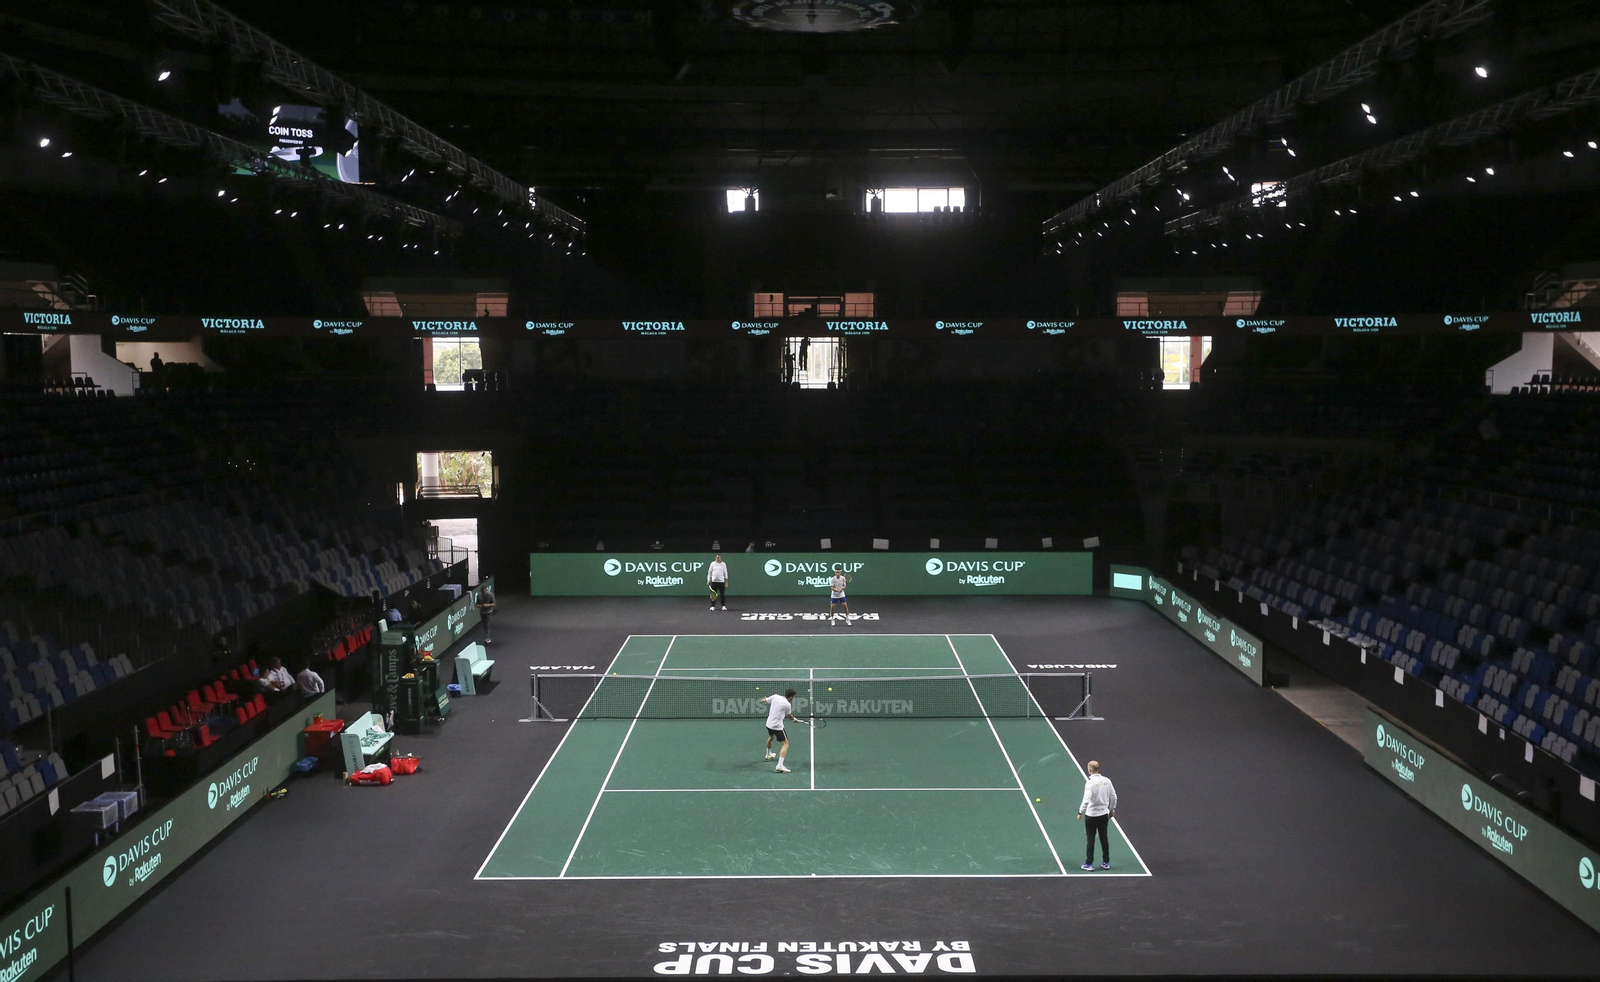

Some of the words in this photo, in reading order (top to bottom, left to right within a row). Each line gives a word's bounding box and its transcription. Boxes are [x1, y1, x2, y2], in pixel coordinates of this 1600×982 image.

[269, 126, 289, 136] COIN
[290, 128, 313, 138] TOSS
[24, 313, 72, 325] VICTORIA
[201, 318, 265, 329] VICTORIA
[1334, 317, 1398, 328] VICTORIA
[1531, 312, 1581, 323] VICTORIA
[412, 321, 477, 330] VICTORIA
[622, 322, 685, 330] VICTORIA
[826, 322, 888, 330] VICTORIA
[1123, 320, 1188, 330] VICTORIA
[625, 562, 667, 573] DAVIS
[671, 562, 702, 573] CUP
[786, 563, 828, 573] DAVIS
[832, 563, 862, 573] CUP
[947, 562, 989, 572] DAVIS
[992, 562, 1024, 572] CUP
[646, 576, 684, 588] Rakuten
[806, 576, 832, 588] Rakut
[967, 575, 1004, 586] Rakuten
[385, 649, 400, 684] Camps
[387, 684, 398, 693] &
[712, 699, 768, 714] DAVIS
[816, 699, 832, 715] by
[837, 700, 913, 714] RAKUTEN
[1386, 734, 1407, 758] DAVIS
[1408, 750, 1424, 769] CUP
[1395, 758, 1414, 782] Rakuten
[219, 768, 241, 797] DAVIS
[243, 757, 258, 778] CUP
[230, 785, 250, 808] Rakuten
[1474, 796, 1502, 826] DAVIS
[1505, 816, 1527, 841] CUP
[119, 836, 150, 872] DAVIS
[152, 820, 172, 846] CUP
[1487, 825, 1513, 855] Rakuten
[135, 853, 162, 882] Rakuten
[0, 929, 22, 959] VIS
[25, 906, 52, 940] CUP
[658, 942, 768, 952] FINALS
[778, 941, 923, 952] RAKUTEN
[932, 941, 971, 952] BY
[653, 954, 774, 974] CUP
[796, 953, 976, 974] DAVIS
